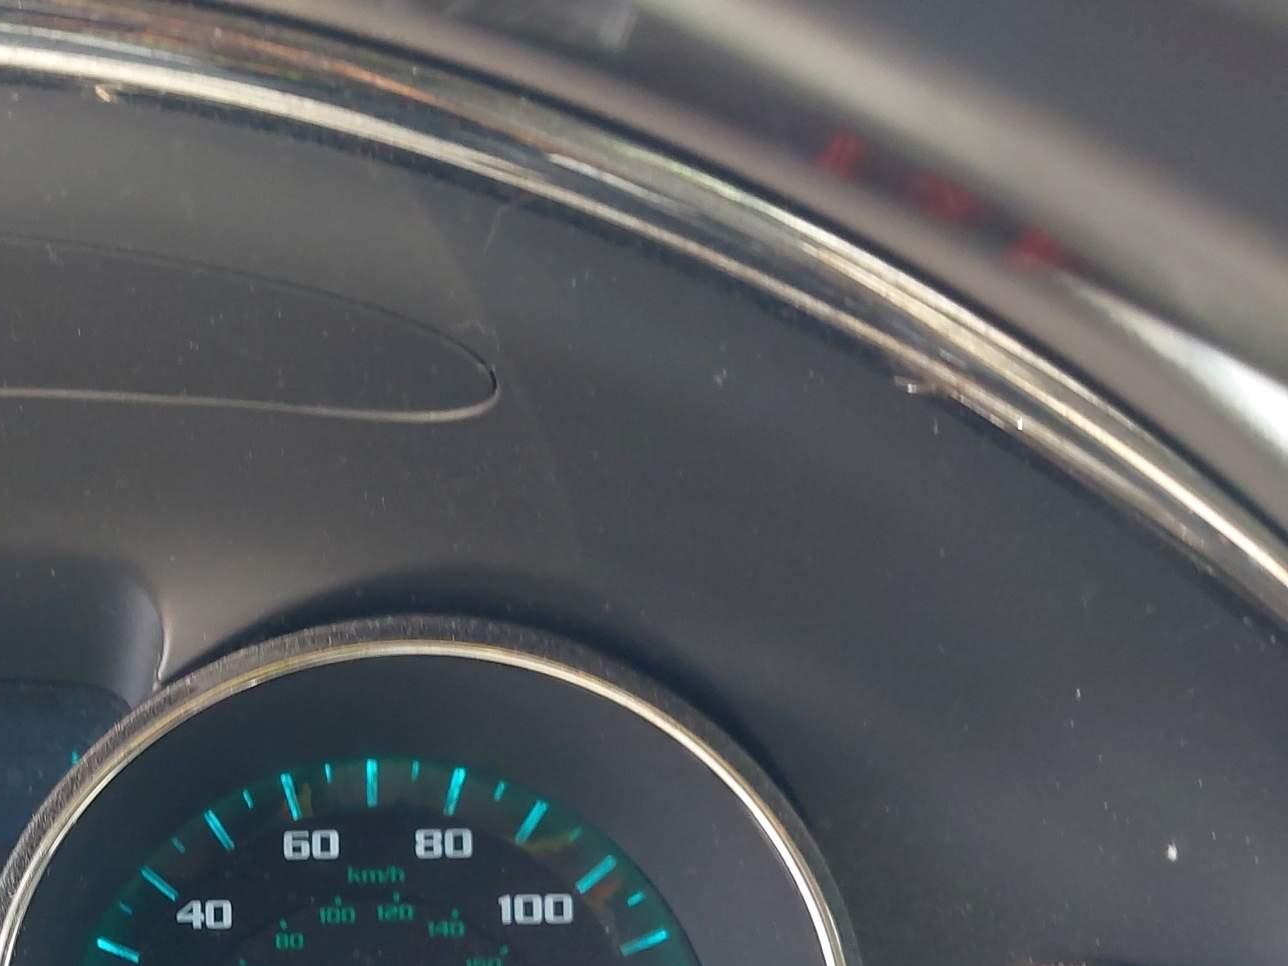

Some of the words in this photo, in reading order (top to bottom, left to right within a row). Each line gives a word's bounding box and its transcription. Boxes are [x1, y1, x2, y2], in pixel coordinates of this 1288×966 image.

[283, 829, 340, 860] 60
[415, 828, 473, 859] 80
[347, 866, 405, 884] km/h
[176, 899, 233, 930] 40
[319, 906, 356, 925] 100
[377, 904, 414, 921] 120
[498, 893, 574, 925] 100
[428, 921, 465, 938] 140
[275, 932, 304, 949] 80
